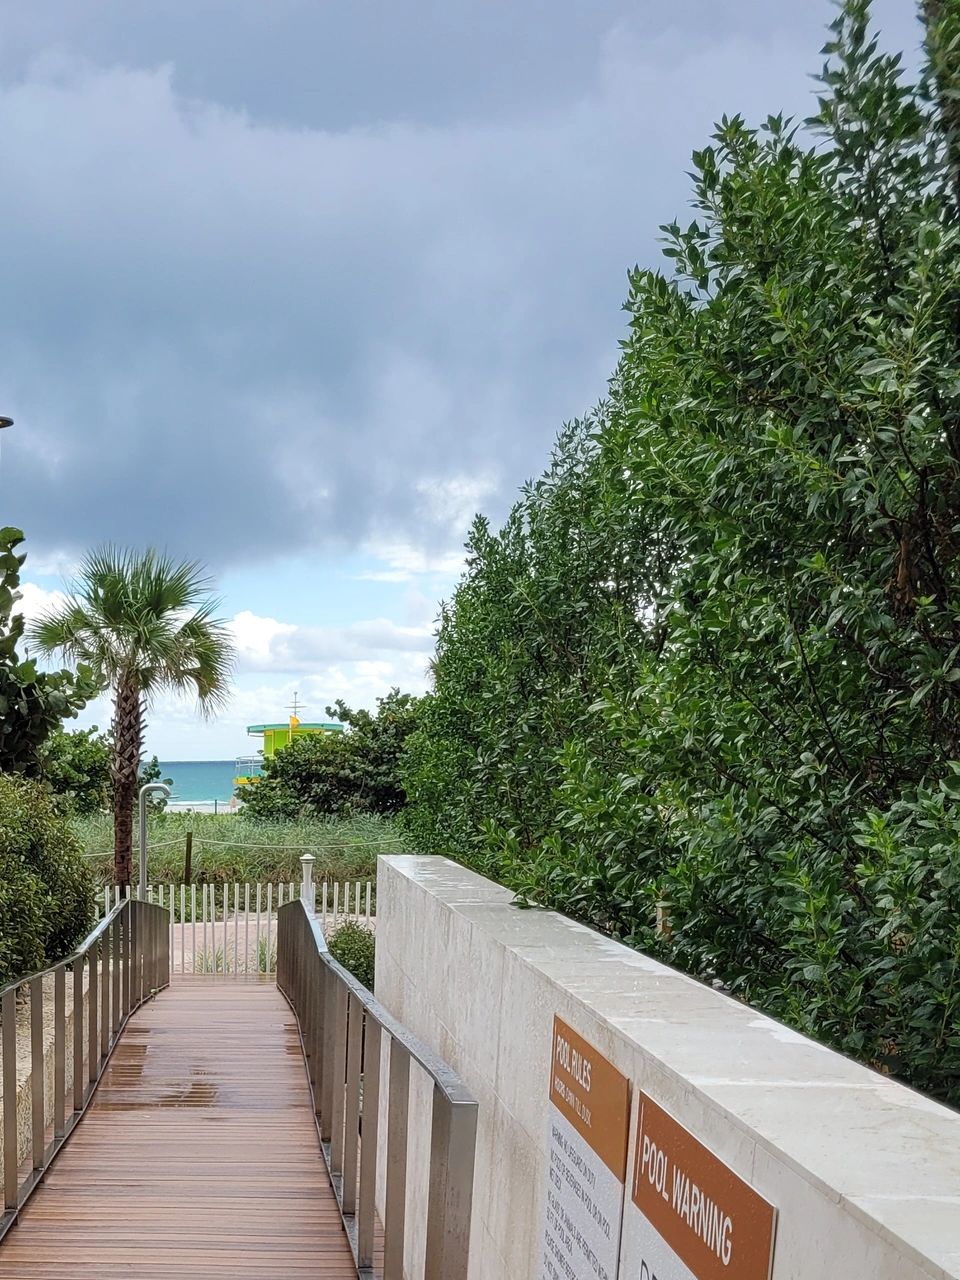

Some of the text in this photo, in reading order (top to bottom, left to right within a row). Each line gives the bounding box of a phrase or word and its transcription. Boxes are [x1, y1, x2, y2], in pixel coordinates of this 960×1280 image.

[556, 1034, 592, 1092] POOL RULES
[641, 1134, 669, 1202] POOL
[672, 1164, 733, 1266] WARNING
